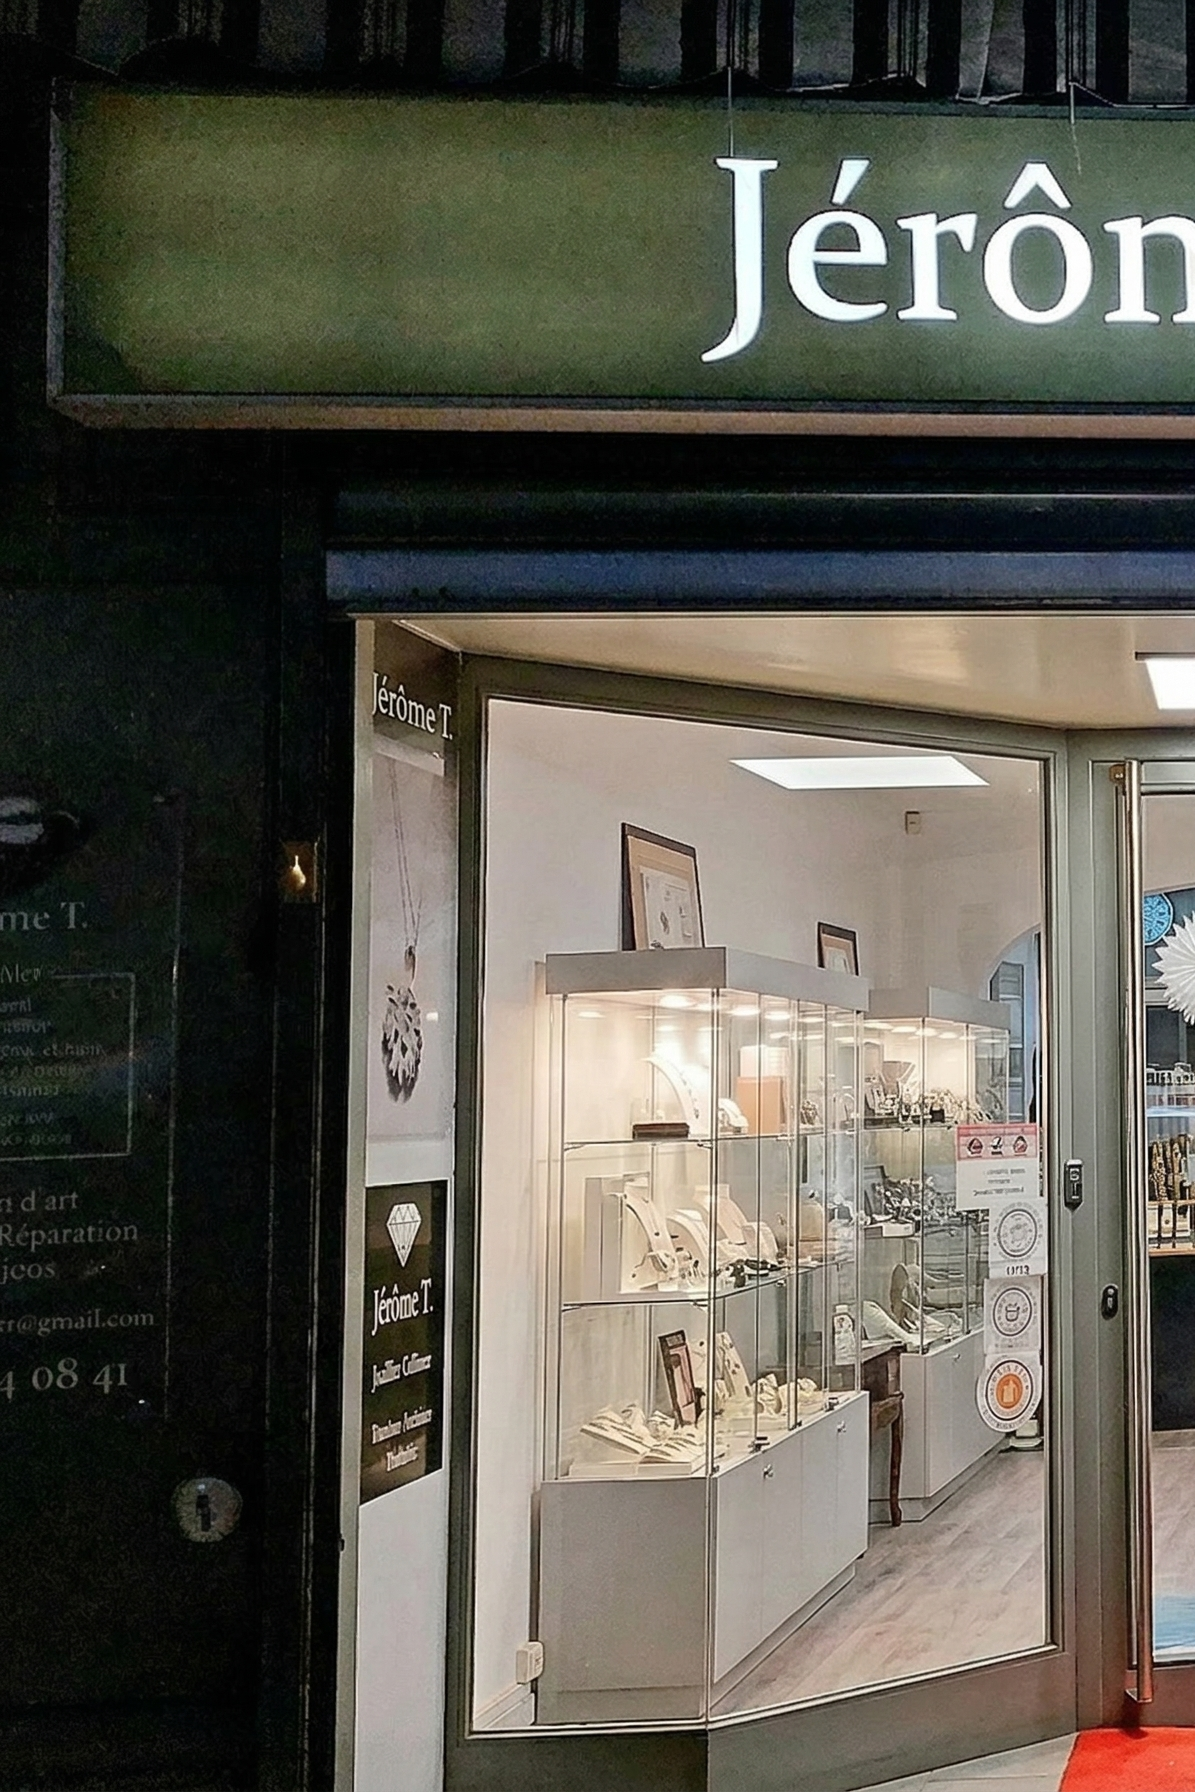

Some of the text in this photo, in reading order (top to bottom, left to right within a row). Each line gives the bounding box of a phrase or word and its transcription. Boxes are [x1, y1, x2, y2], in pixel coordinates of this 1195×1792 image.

[371, 671, 453, 741] Jérôme T.
[60, 901, 89, 930] T.
[371, 1278, 434, 1336] Jérôme T.
[32, 1357, 79, 1391] 08
[92, 1363, 128, 1395] 41
